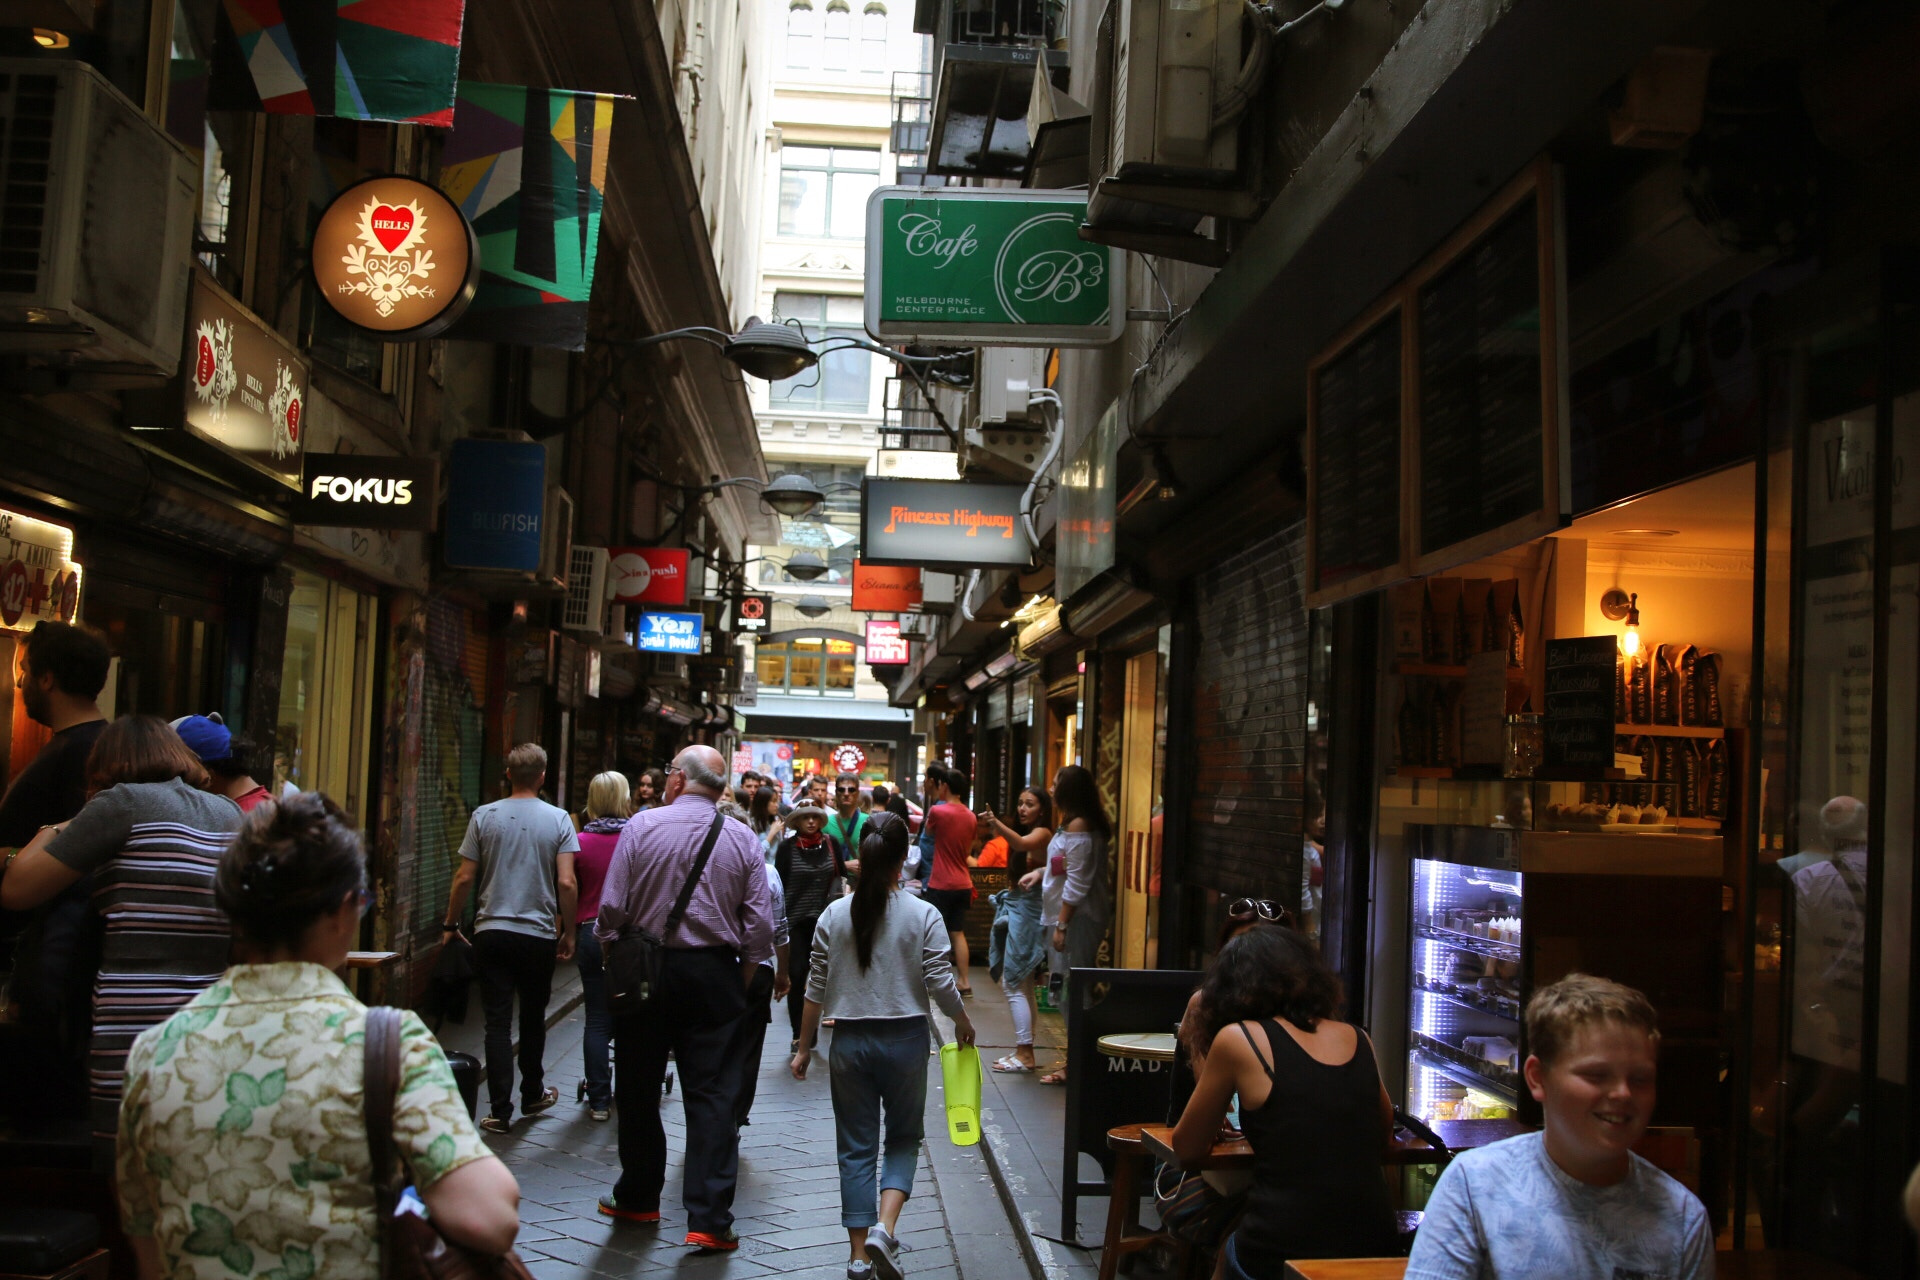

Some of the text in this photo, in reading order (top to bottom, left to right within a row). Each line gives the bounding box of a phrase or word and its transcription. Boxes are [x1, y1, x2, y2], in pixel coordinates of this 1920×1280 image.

[374, 219, 410, 231] HELLS
[897, 212, 978, 270] Cafe
[895, 305, 986, 315] CENTER PLACE
[896, 296, 971, 306] MELBOURNE
[246, 374, 263, 395] HELLS
[241, 389, 265, 415] UPSTAIRS
[311, 475, 414, 505] FOKUS
[471, 511, 539, 533] BLUFISH
[883, 506, 1014, 539] Princess Highway
[651, 563, 678, 576] rush
[646, 615, 695, 634] Yen
[640, 631, 666, 648] Sushi
[869, 645, 906, 660] mini
[1108, 1056, 1163, 1073] MAD
